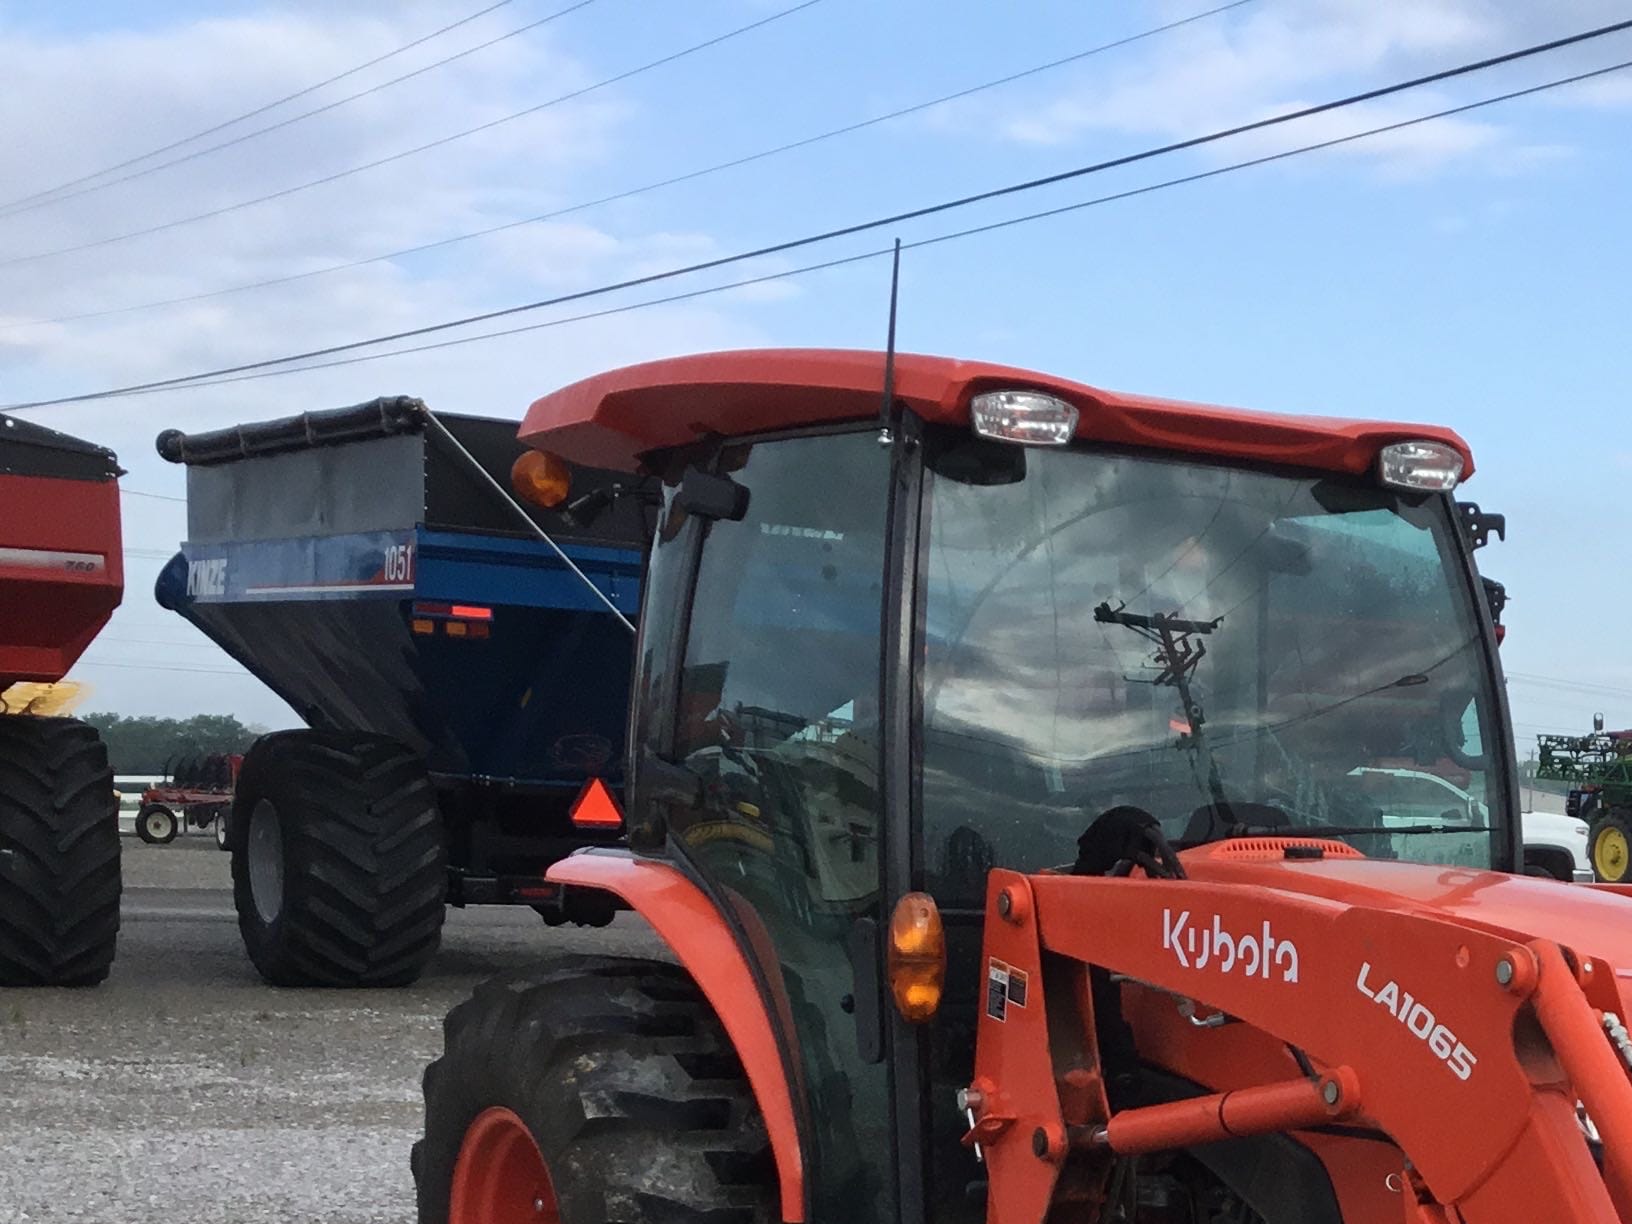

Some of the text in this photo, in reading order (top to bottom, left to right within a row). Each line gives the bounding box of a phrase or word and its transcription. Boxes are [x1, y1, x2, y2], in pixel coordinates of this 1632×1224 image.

[64, 561, 96, 573] 760
[384, 545, 413, 581] 1051
[1163, 908, 1299, 983] Kubota
[1356, 961, 1478, 1080] LA1065
